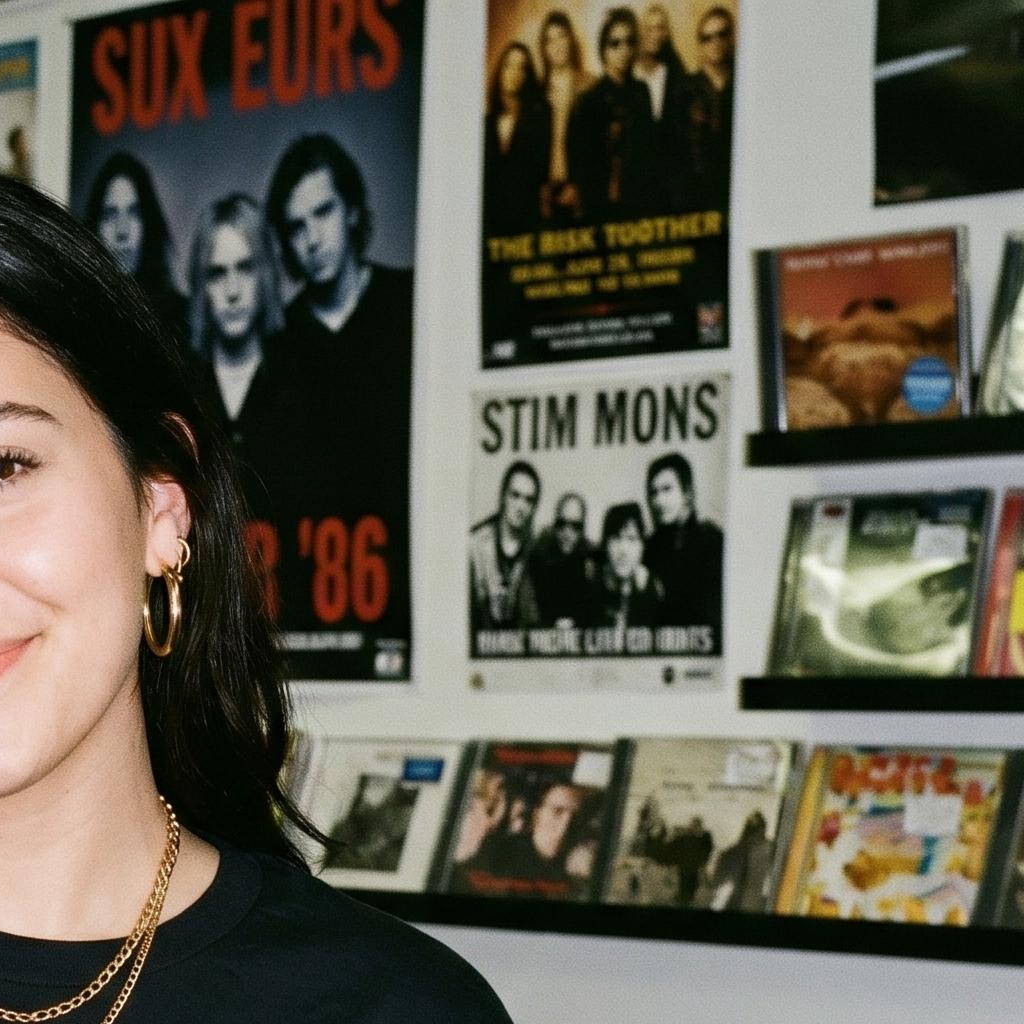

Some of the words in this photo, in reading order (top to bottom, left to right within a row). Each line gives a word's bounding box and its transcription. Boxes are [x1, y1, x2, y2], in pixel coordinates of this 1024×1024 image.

[91, 10, 208, 136] SUX
[232, 0, 401, 112] EURS
[487, 233, 535, 263] THE
[481, 394, 578, 455] STIM
[594, 381, 718, 445] MONS
[298, 514, 389, 623] '86
